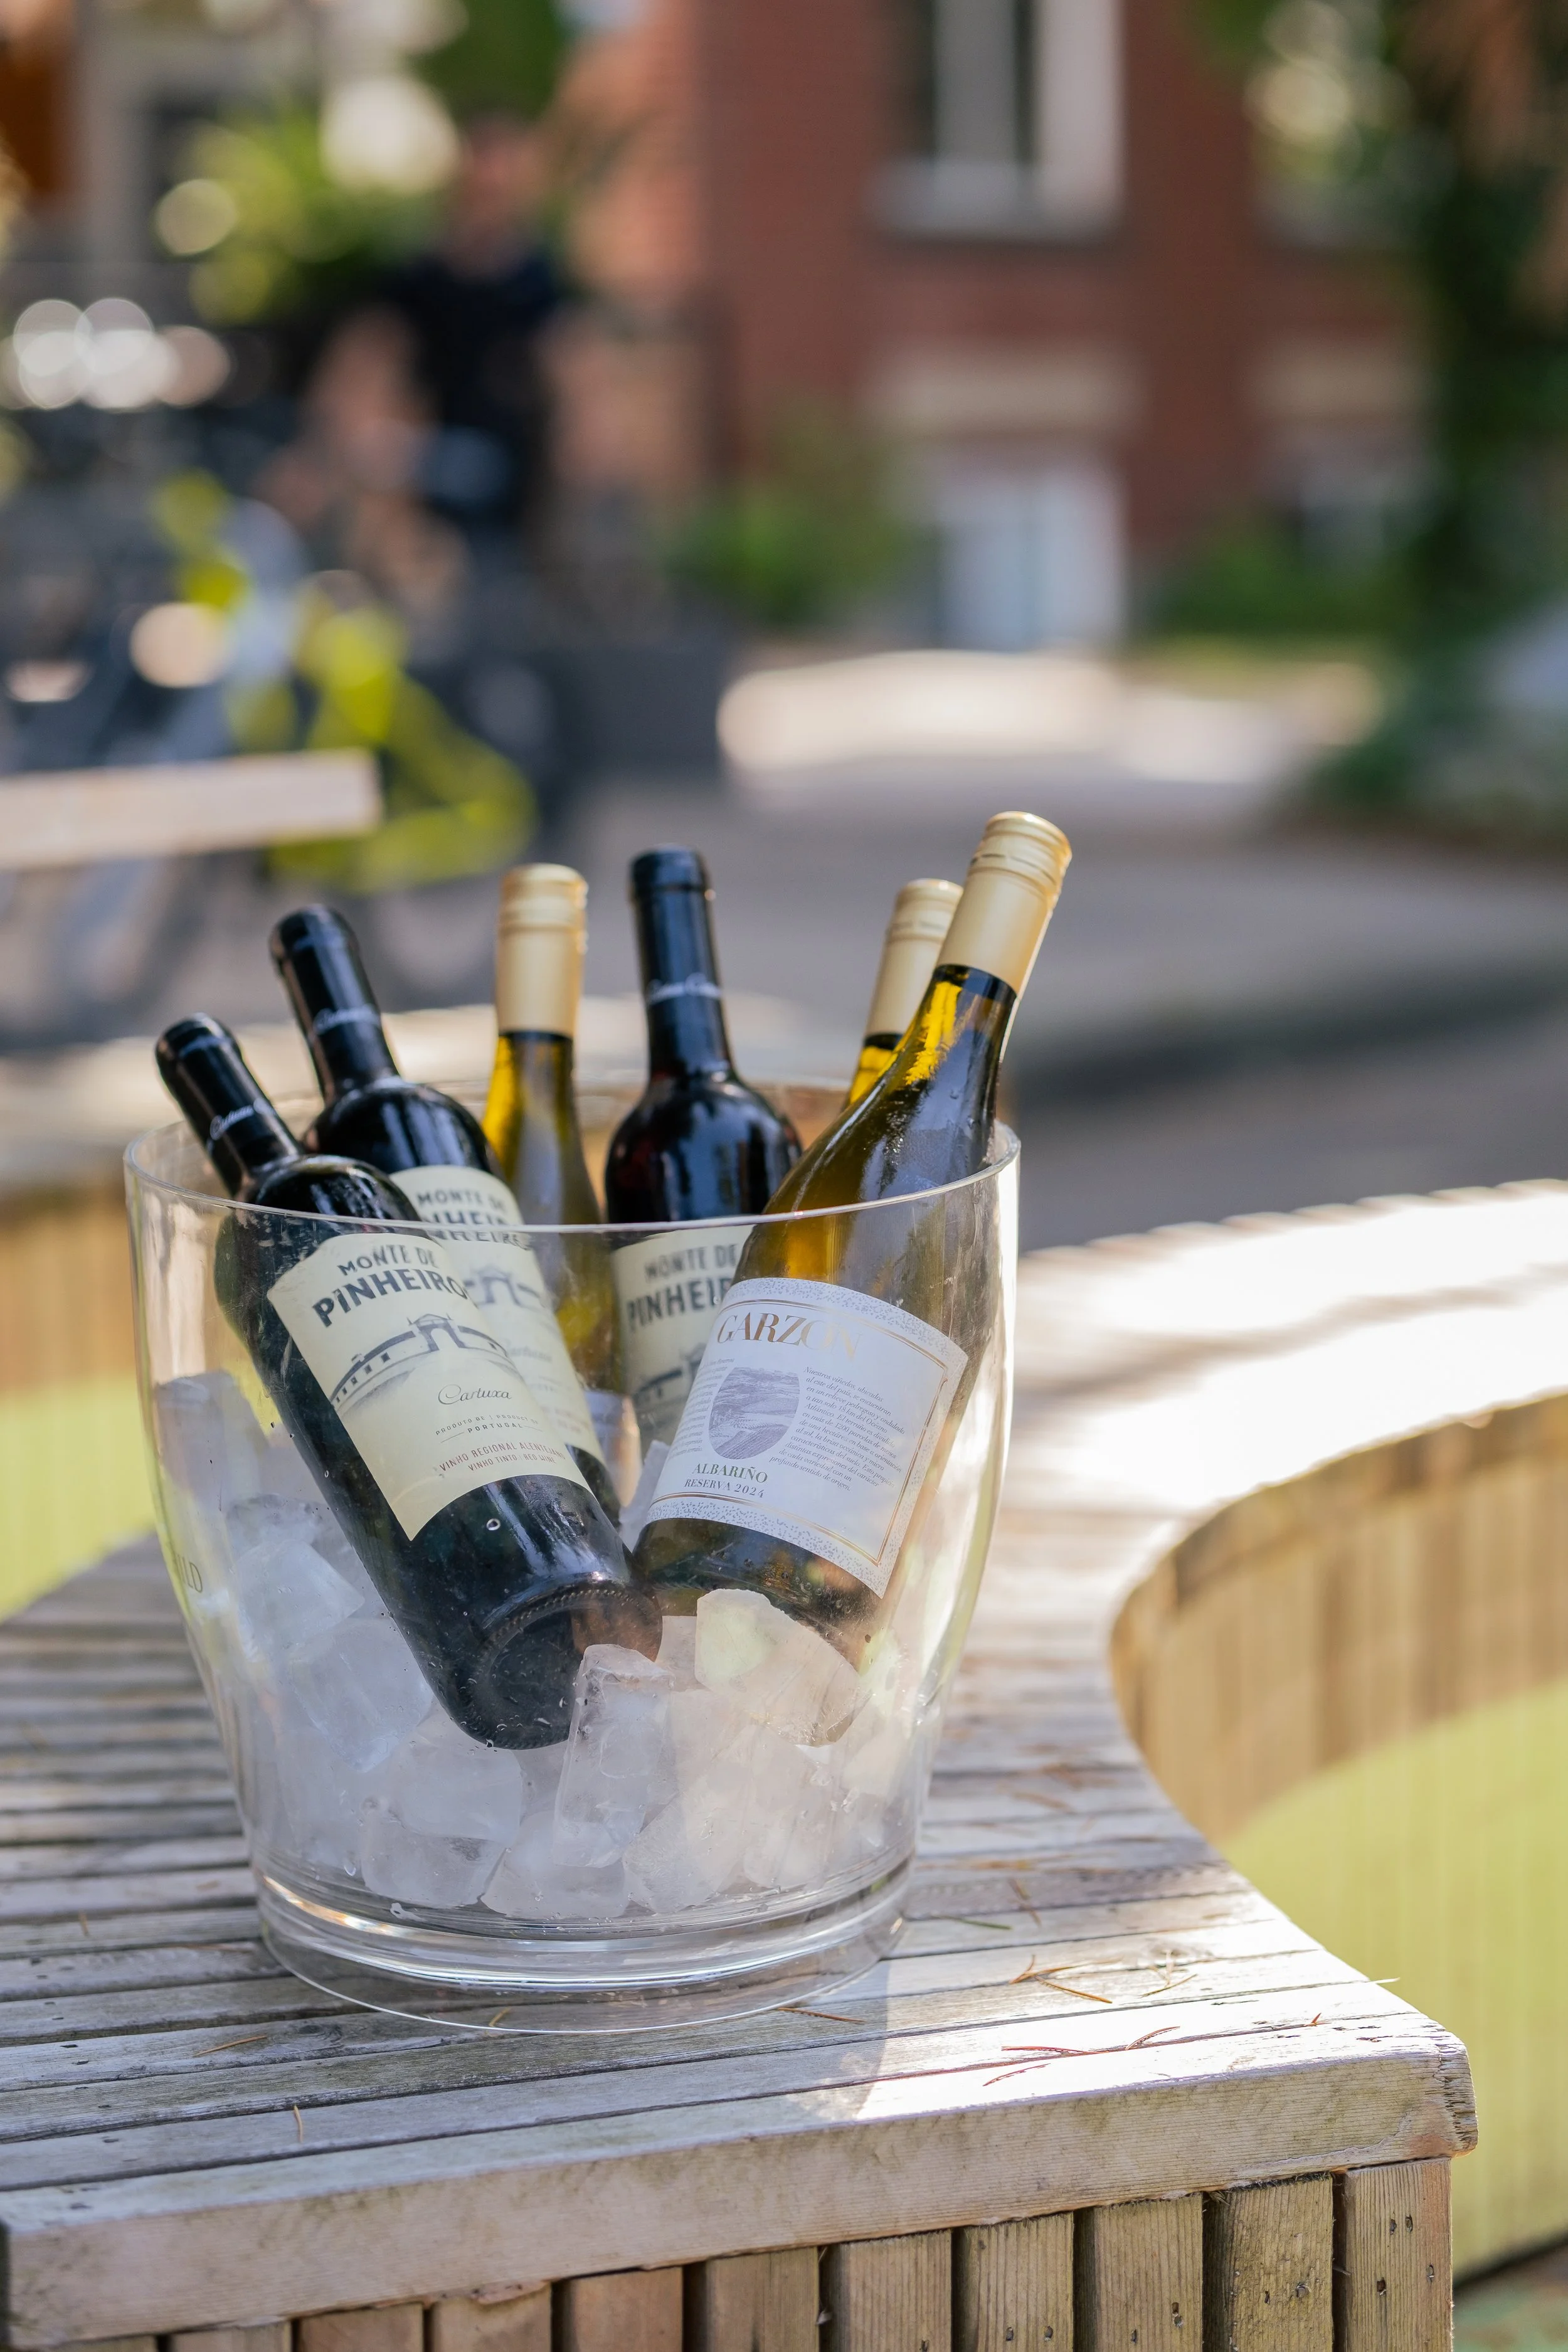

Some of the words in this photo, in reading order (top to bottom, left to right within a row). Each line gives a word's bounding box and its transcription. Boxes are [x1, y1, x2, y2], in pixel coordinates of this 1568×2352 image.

[337, 1244, 411, 1276] MONTE
[414, 1246, 439, 1268] DE
[644, 1247, 707, 1283] MONTE
[714, 1244, 736, 1268] DE
[312, 1269, 468, 1328] PINHEIRO
[438, 1384, 512, 1405] Cartuxa
[803, 1367, 832, 1380] Nuestros
[832, 1377, 856, 1391] viñedos,
[857, 1386, 884, 1402] ubicados
[826, 1382, 839, 1391] del
[836, 1388, 852, 1398] país,
[859, 1398, 892, 1416] encuentran
[435, 1418, 473, 1436] PRODUTO
[467, 1422, 523, 1434] PORTUGAL
[811, 1396, 824, 1404] tan
[824, 1401, 837, 1409] solo
[838, 1404, 846, 1412] 18
[846, 1408, 856, 1417] km
[856, 1412, 867, 1422] del
[866, 1417, 887, 1434] Océano
[825, 1392, 847, 1406] relieve
[845, 1399, 876, 1417] pedregoso
[880, 1416, 905, 1434] ondulado
[811, 1414, 825, 1423] más
[835, 1422, 850, 1433] 1200
[847, 1429, 873, 1445] parcelas
[880, 1446, 896, 1459] menos
[837, 1414, 845, 1422] El
[845, 1417, 866, 1432] terruño
[873, 1432, 896, 1448] dividido
[439, 1453, 469, 1471] VINHO
[471, 1442, 517, 1458] REGIONAL
[519, 1442, 566, 1461] ALENTEJANO
[467, 1458, 494, 1471] VINHO
[494, 1453, 517, 1463] TINTO
[523, 1453, 538, 1461] RED
[539, 1454, 558, 1465] WINE
[785, 1442, 812, 1455] distintas
[812, 1451, 848, 1470] expresiones
[847, 1465, 858, 1475] del
[857, 1471, 879, 1487] carácter
[790, 1435, 835, 1455] características
[835, 1449, 847, 1459] del
[862, 1463, 874, 1475] Esto
[804, 1429, 813, 1438] sol,
[823, 1435, 839, 1448] brisa
[839, 1443, 864, 1459] oceánica
[869, 1458, 884, 1471] micro
[822, 1426, 849, 1442] hectárea
[856, 1441, 870, 1453] base
[874, 1453, 903, 1473] orientación
[692, 1463, 768, 1483] ALBARIÑO
[769, 1456, 800, 1470] profundo
[799, 1465, 822, 1478] sentido
[830, 1478, 851, 1491] origen.
[787, 1451, 803, 1461] cada
[803, 1456, 834, 1473] variedad
[833, 1469, 844, 1478] con
[844, 1475, 853, 1483] un
[684, 1478, 731, 1491] RESERVA
[734, 1483, 765, 1498] 2024
